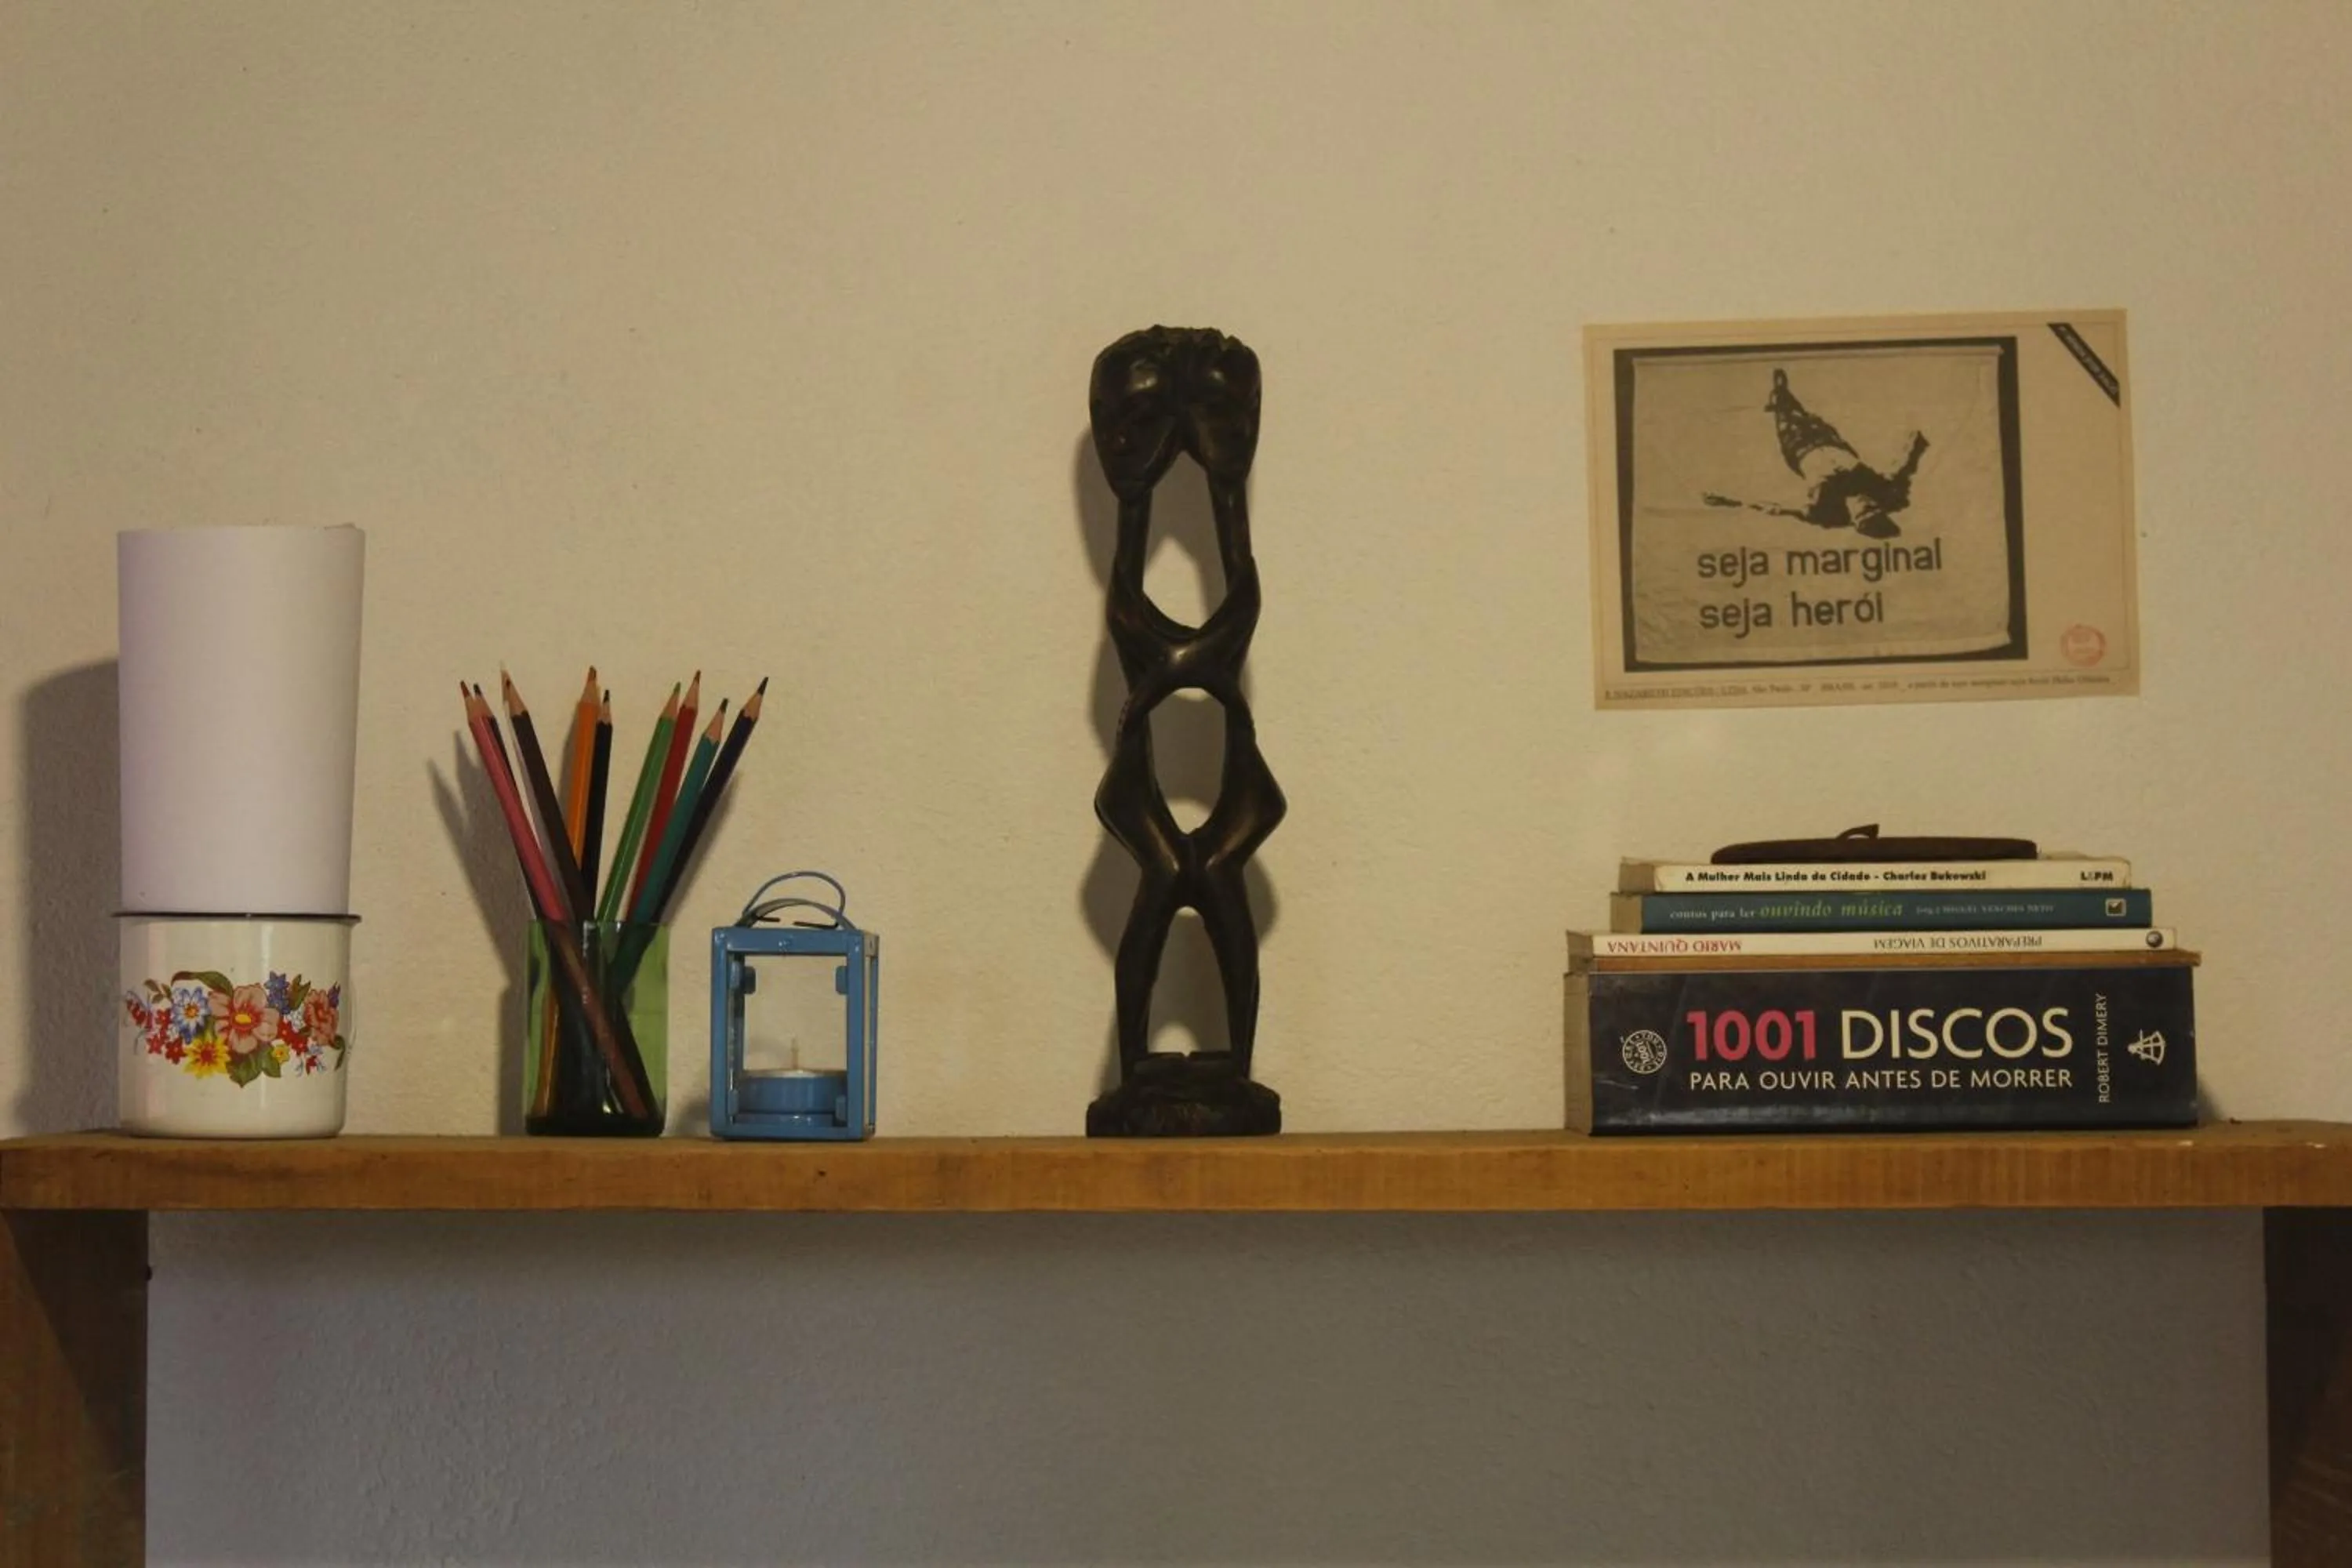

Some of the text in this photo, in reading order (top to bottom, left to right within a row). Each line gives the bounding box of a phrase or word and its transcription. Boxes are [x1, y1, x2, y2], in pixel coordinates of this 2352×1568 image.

[1697, 537, 1943, 588] seja marginal
[1700, 591, 1884, 639] seja herói
[1686, 872, 1694, 881] A
[1697, 871, 1740, 881] Mulher
[1743, 871, 1772, 881] Mais
[1775, 871, 1808, 882] Linda
[1812, 871, 1826, 881] da
[1830, 870, 1871, 881] Cidade
[1882, 870, 1926, 881] Charles
[1930, 870, 1986, 881] Bukowski
[1711, 909, 1735, 921] para
[1759, 899, 1832, 918] ouvindo
[1841, 898, 1904, 917] música
[1607, 938, 1742, 953] MARIO QUINTANA
[1874, 936, 2042, 949] PREPARATIVOS DE VIAGEM
[1686, 1010, 1817, 1061] 1001
[1842, 1007, 2074, 1059] DISCOS
[2094, 992, 2111, 1104] ROBERT DIMERY
[1690, 1068, 2073, 1090] PARA OUVIR ANTES DE MORRER
